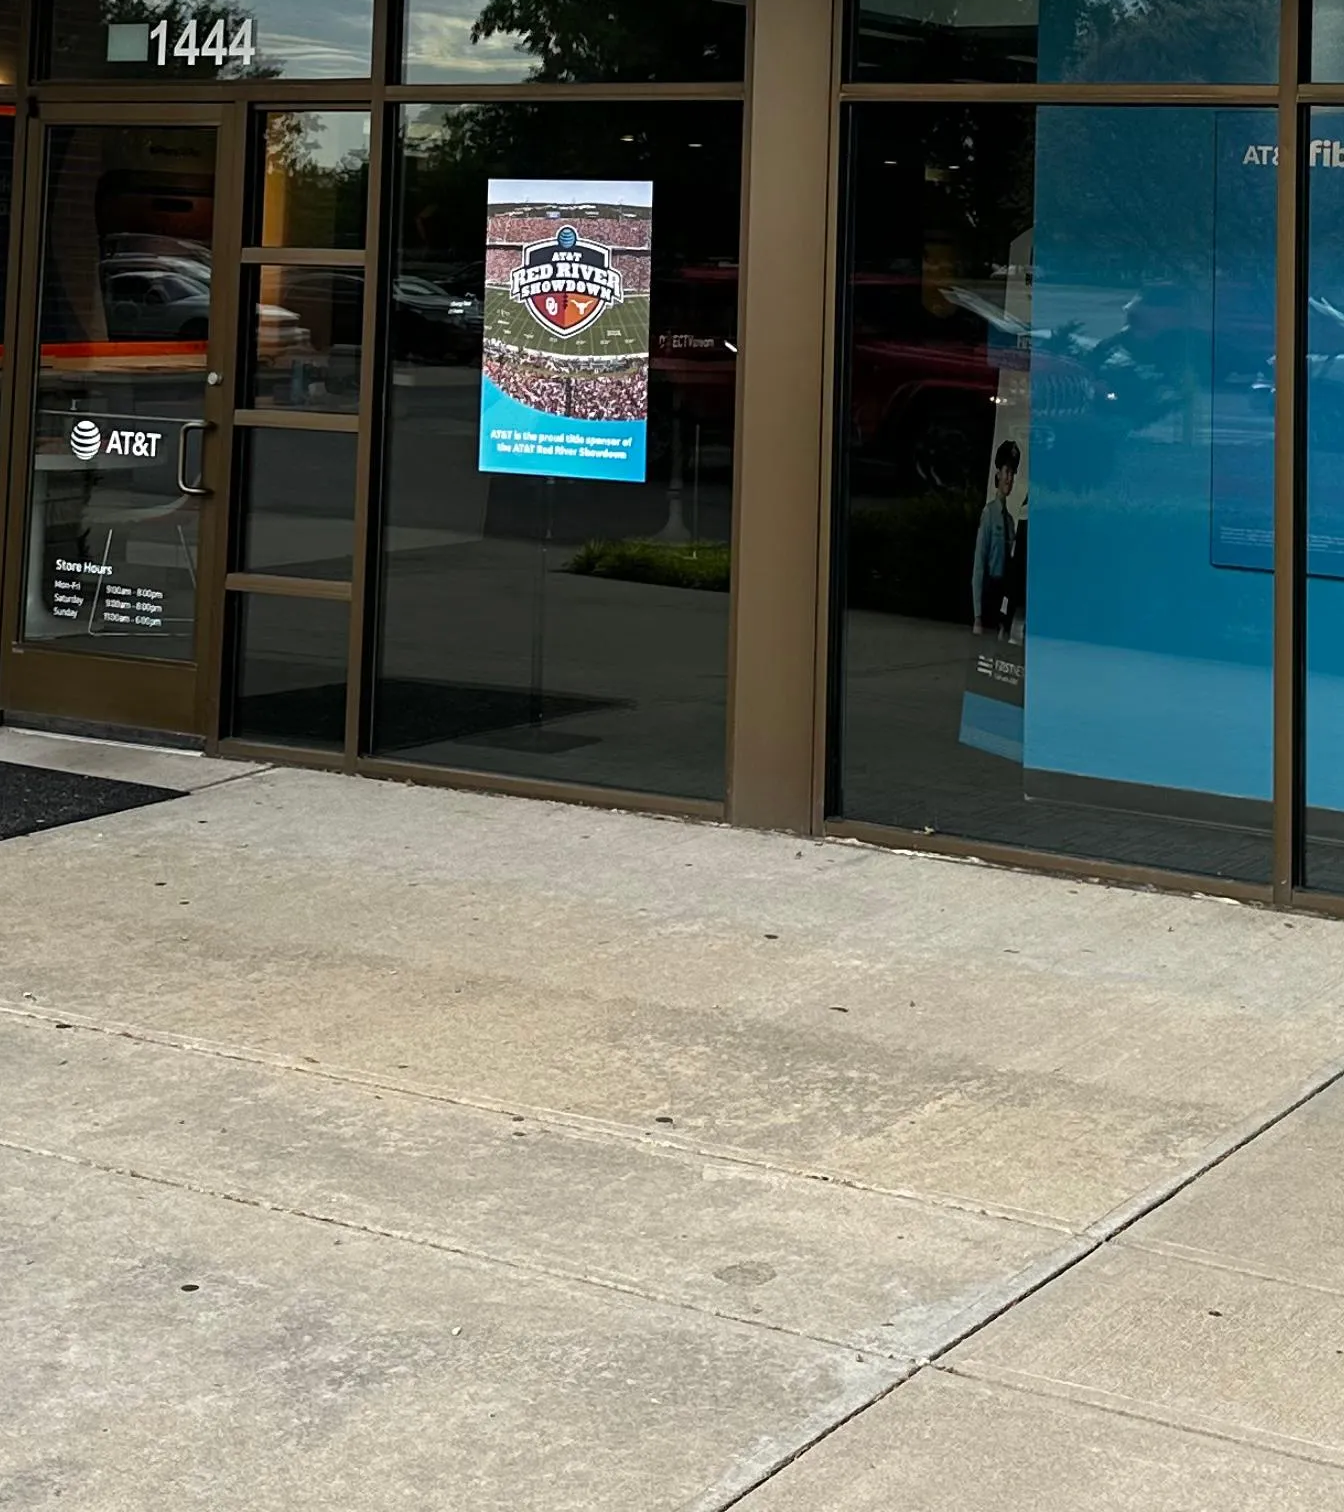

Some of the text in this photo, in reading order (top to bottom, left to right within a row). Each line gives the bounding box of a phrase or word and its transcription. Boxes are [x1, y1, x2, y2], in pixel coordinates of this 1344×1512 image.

[150, 19, 255, 66] 1444
[552, 251, 582, 262] AT&T
[512, 261, 621, 299] RED RIVER
[521, 279, 613, 302] SHOWDOWN
[105, 430, 162, 457] AT&T
[490, 429, 513, 440] AT&T
[522, 430, 537, 441] the
[539, 432, 565, 444] proud
[565, 433, 584, 444] title
[585, 436, 621, 447] sponsor
[621, 436, 633, 447] of
[496, 442, 627, 460] the AT&T Red River Showdown
[55, 558, 113, 576] Store Hours
[53, 592, 85, 606] Saturday
[52, 606, 79, 619] Sunday
